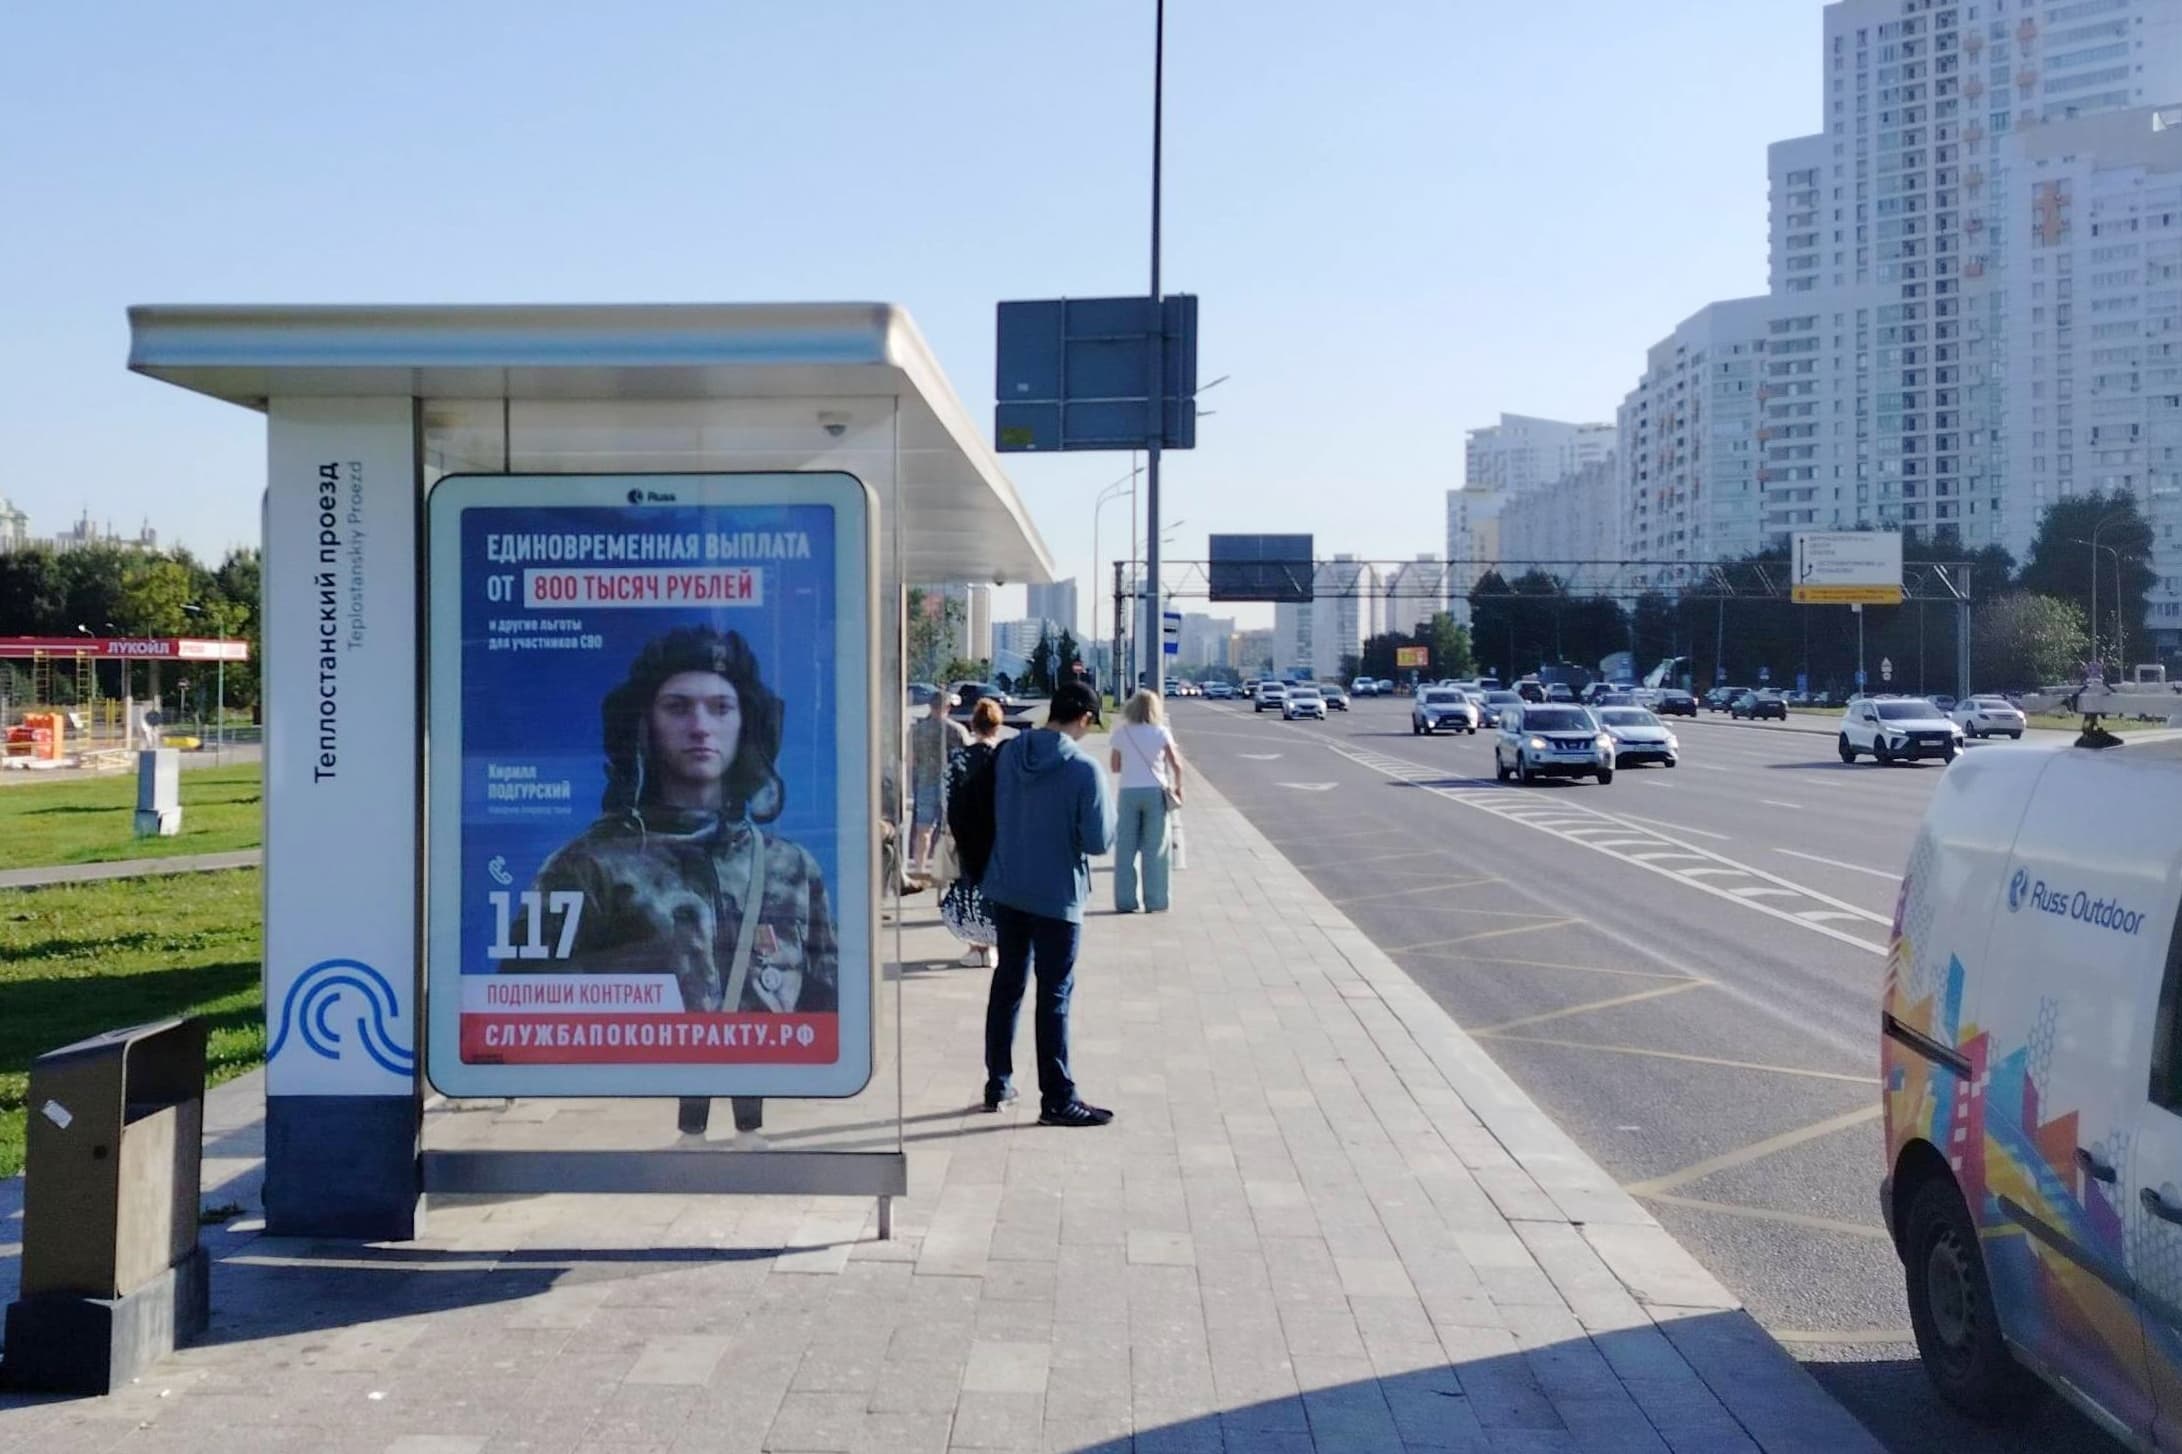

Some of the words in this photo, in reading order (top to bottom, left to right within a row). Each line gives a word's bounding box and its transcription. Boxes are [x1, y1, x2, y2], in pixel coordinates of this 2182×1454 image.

[347, 461, 363, 524] Proezd
[319, 462, 341, 563] проезд
[487, 534, 699, 563] ЕДИНОВРЕМЕННАЯ
[705, 532, 811, 559] ВЫПЛАТА
[347, 530, 366, 650] Teplostanskiy
[487, 575, 515, 602] ОТ
[534, 575, 577, 601] 800
[583, 574, 660, 600] ТЫСЯЧ
[667, 569, 752, 600] РУБЛЕЙ
[107, 640, 170, 654] ЛУКОЙЛ
[580, 635, 602, 649] СВО
[315, 572, 337, 784] Теплостанский
[488, 780, 571, 801] ПОДГУРСКИЙ
[2030, 880, 2069, 915] Russ
[2071, 891, 2145, 934] Outdoor
[487, 890, 585, 960] 117
[487, 984, 574, 1005] ПОДПИШИ
[580, 984, 664, 1004] КОНТРАКТ
[485, 1023, 815, 1048] СЛУЖБАПОКОНТРАКТУ.РФ
